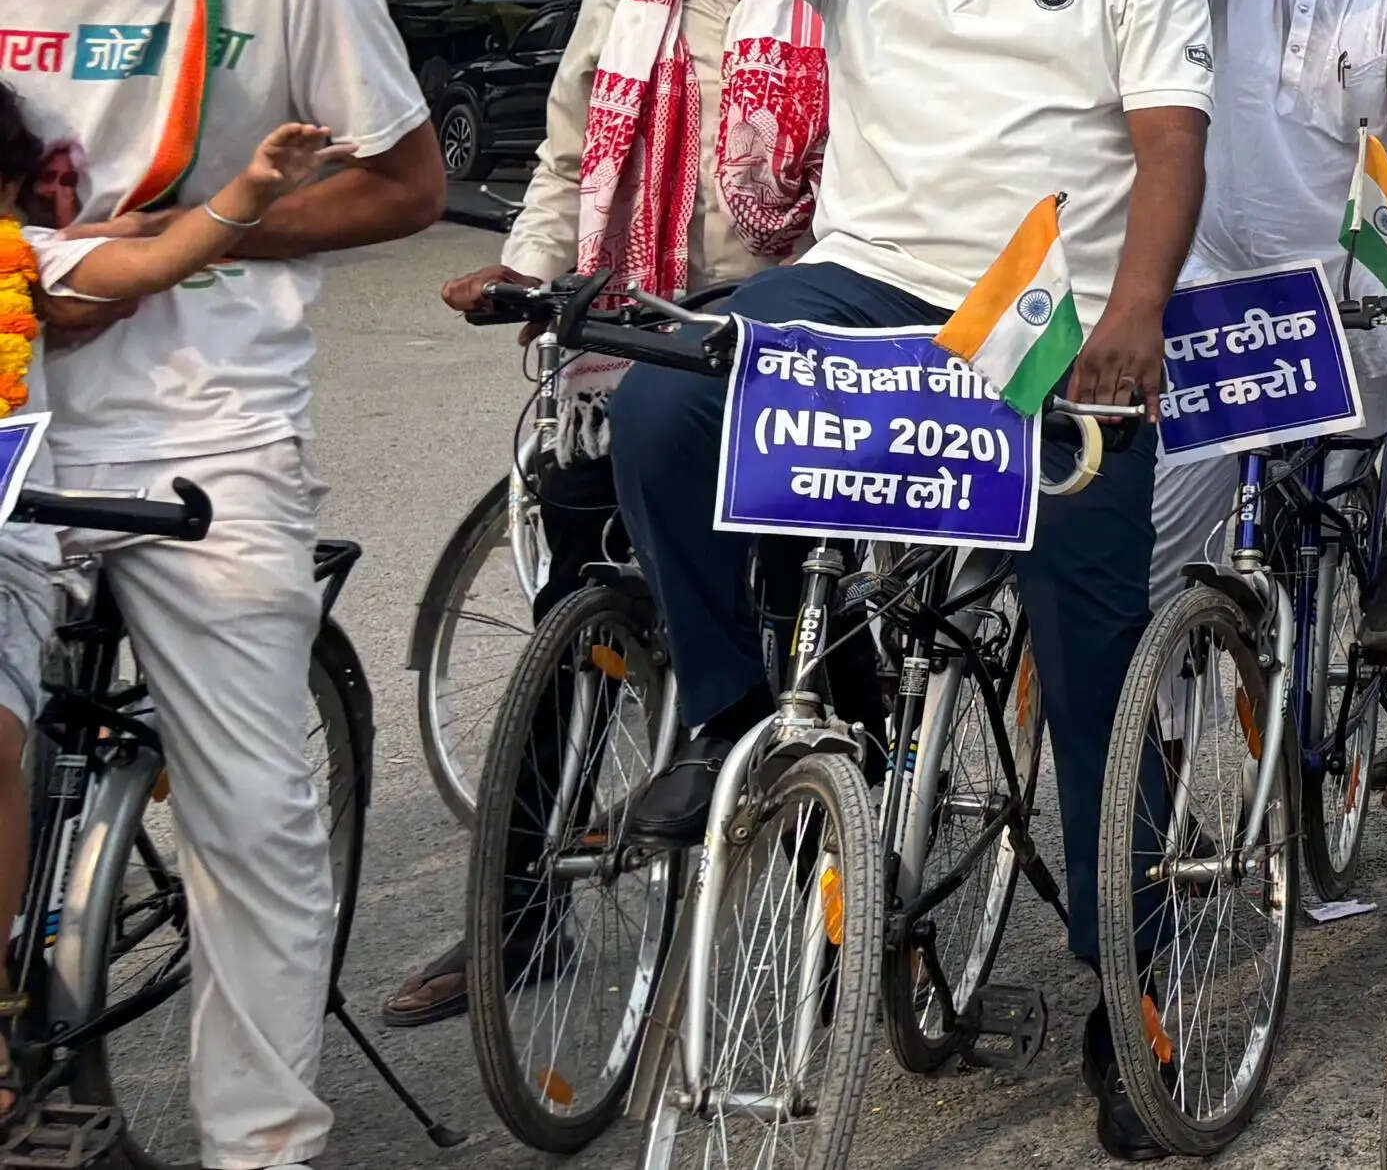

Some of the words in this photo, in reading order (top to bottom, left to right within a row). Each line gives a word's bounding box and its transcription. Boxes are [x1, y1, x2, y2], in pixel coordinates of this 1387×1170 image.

[1164, 328, 1219, 361] पर
[1222, 308, 1317, 354] लीक
[756, 347, 817, 386] नई
[822, 357, 923, 394] शिक्षा
[1159, 381, 1210, 420] बंद
[1216, 358, 1317, 405] करो!
[755, 408, 872, 455] (NEP
[888, 417, 1011, 473] 2020)
[791, 466, 903, 505] वापस
[905, 467, 973, 511] लो!
